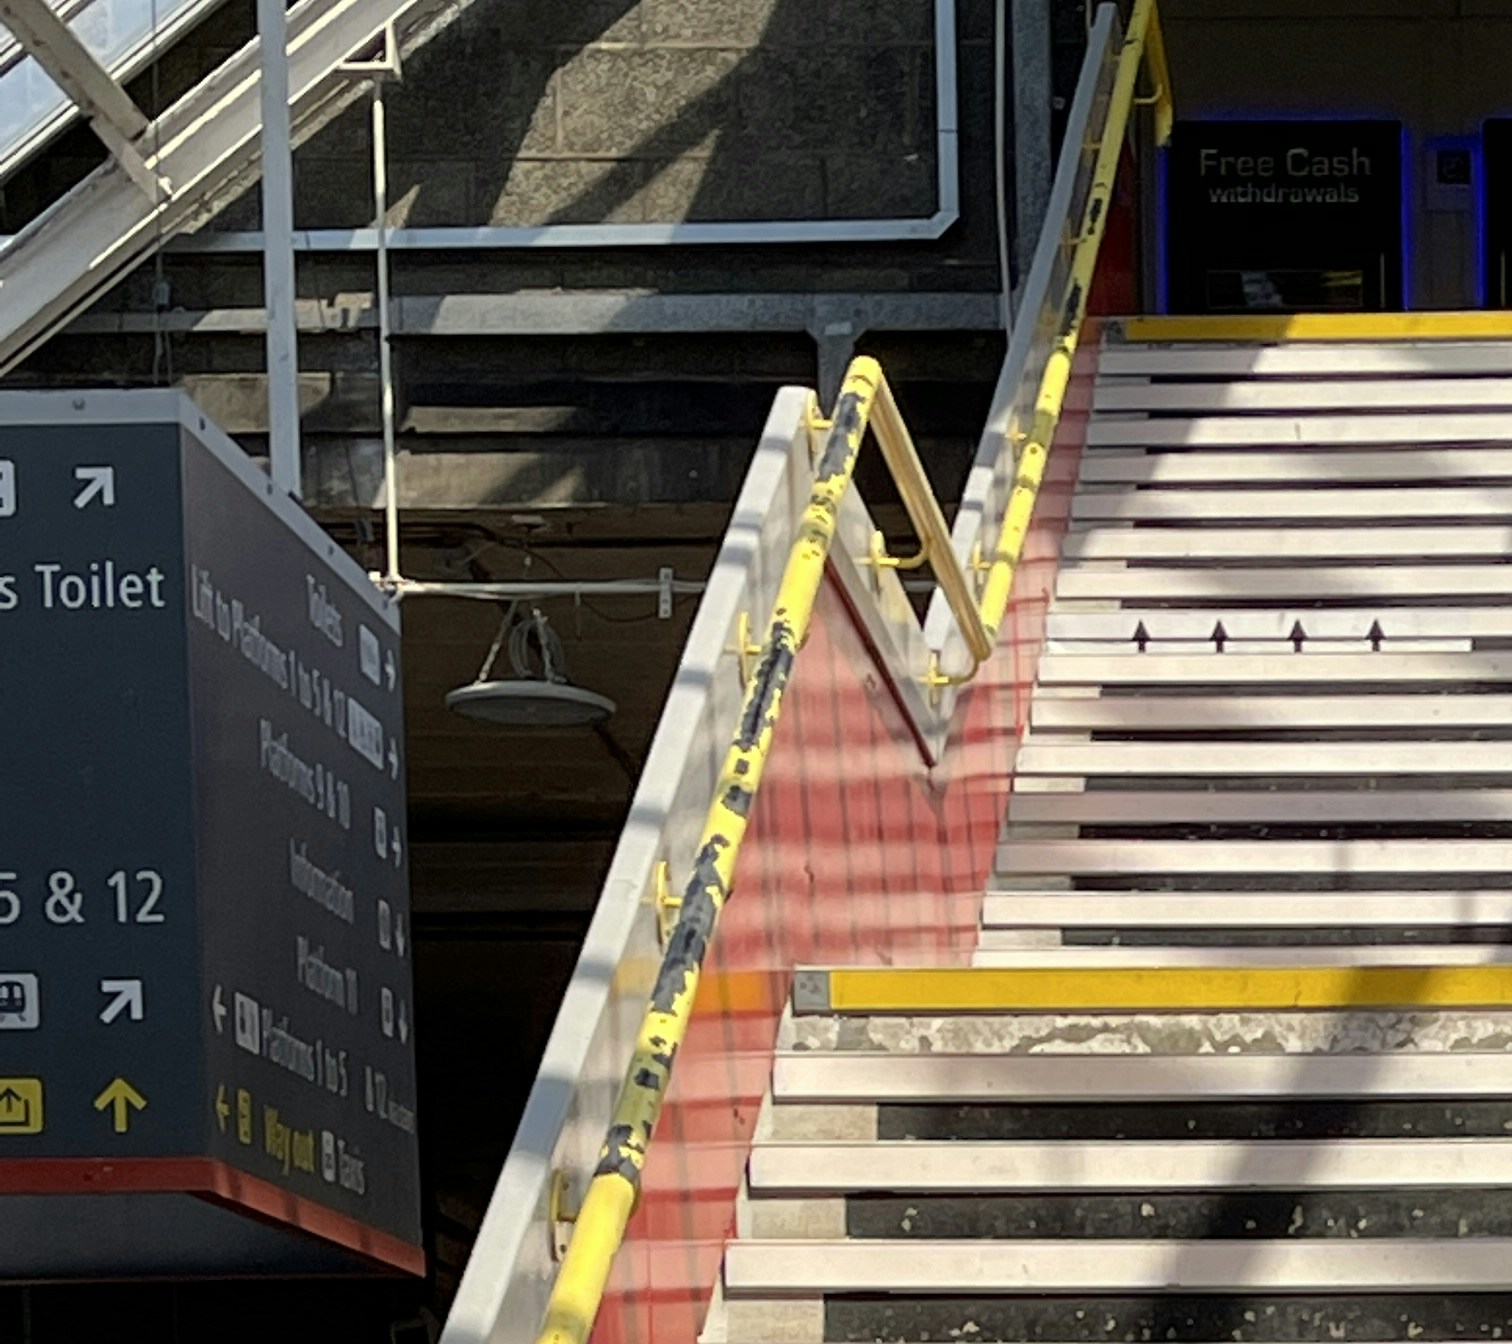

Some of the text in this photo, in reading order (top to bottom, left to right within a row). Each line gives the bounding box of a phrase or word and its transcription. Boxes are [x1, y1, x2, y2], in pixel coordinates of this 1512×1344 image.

[1200, 147, 1371, 177] Free Cash
[1208, 182, 1360, 203] withdrawals
[34, 560, 165, 609] Toilet
[45, 871, 84, 923] &
[107, 871, 164, 922] 12
